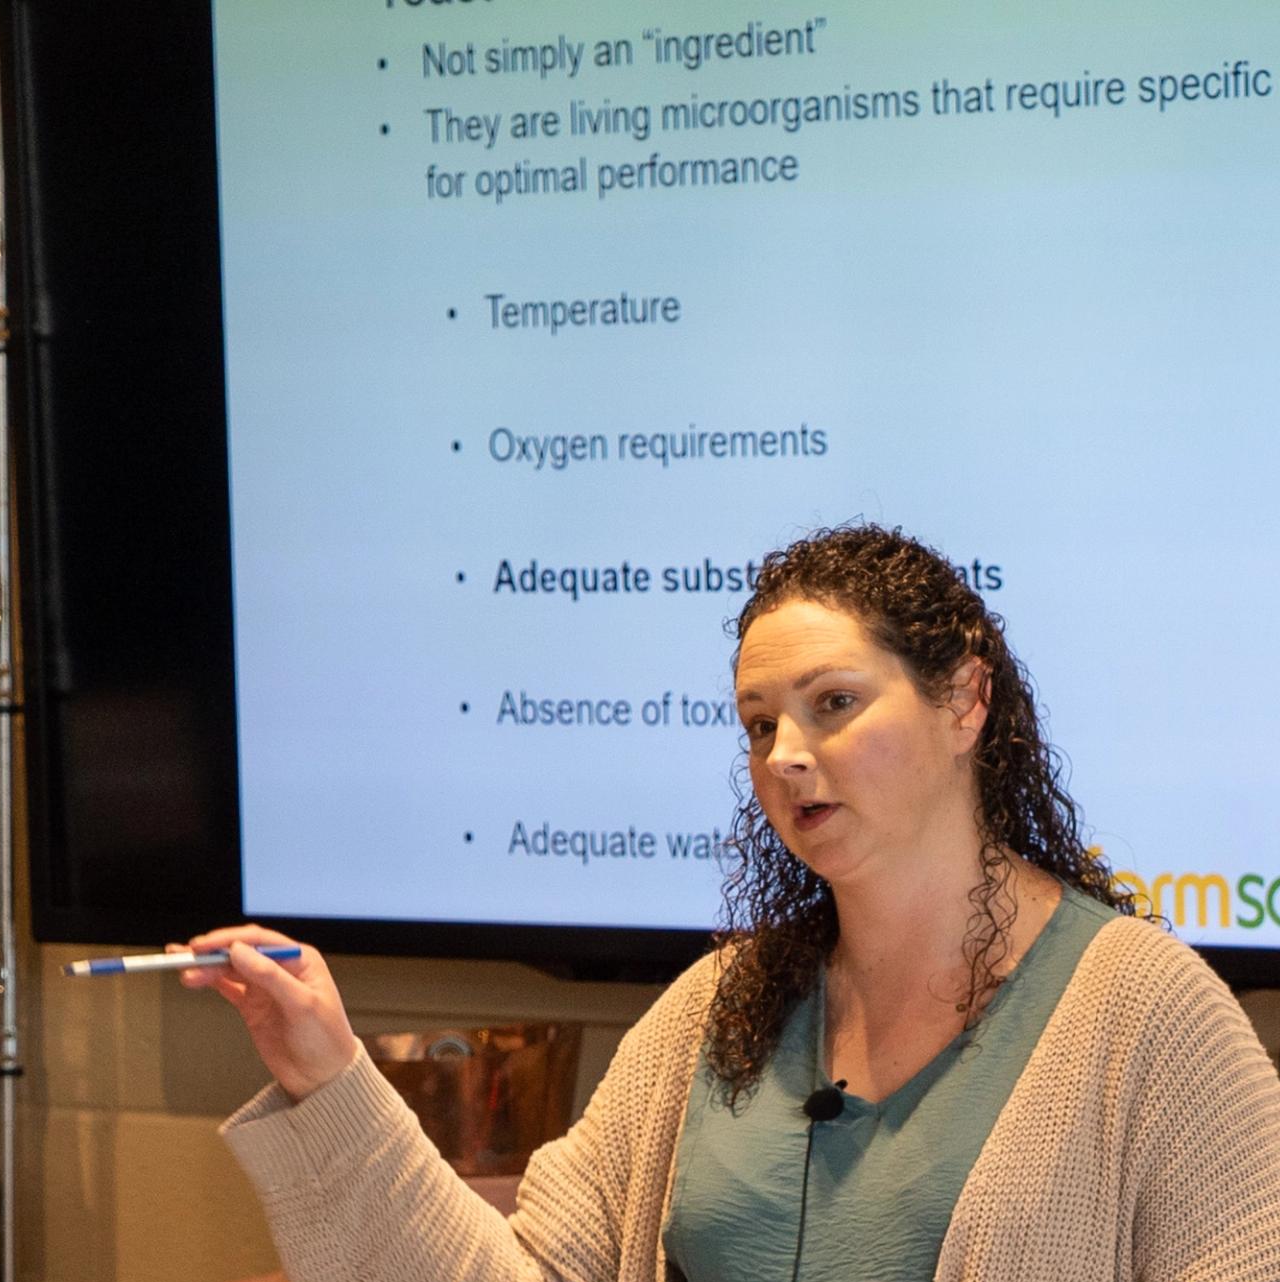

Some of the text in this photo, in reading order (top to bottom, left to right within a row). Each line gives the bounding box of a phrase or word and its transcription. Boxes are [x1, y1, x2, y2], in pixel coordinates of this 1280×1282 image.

[422, 42, 477, 78] Not
[484, 34, 584, 79] simply
[594, 37, 633, 67] an
[425, 106, 500, 149] They
[509, 110, 559, 139] are
[569, 99, 651, 141] living
[661, 84, 920, 134] microorganisms
[931, 77, 995, 116] that
[1006, 69, 1126, 118] require
[1138, 61, 1273, 112] specific
[426, 152, 799, 204] for optimal performance
[485, 291, 681, 336] Temperature
[488, 423, 828, 471] Oxygen requirements
[494, 558, 651, 602] Adequate
[663, 558, 757, 593] subst
[497, 690, 737, 728] Absence of toxi
[508, 819, 740, 866] Adequate wate
